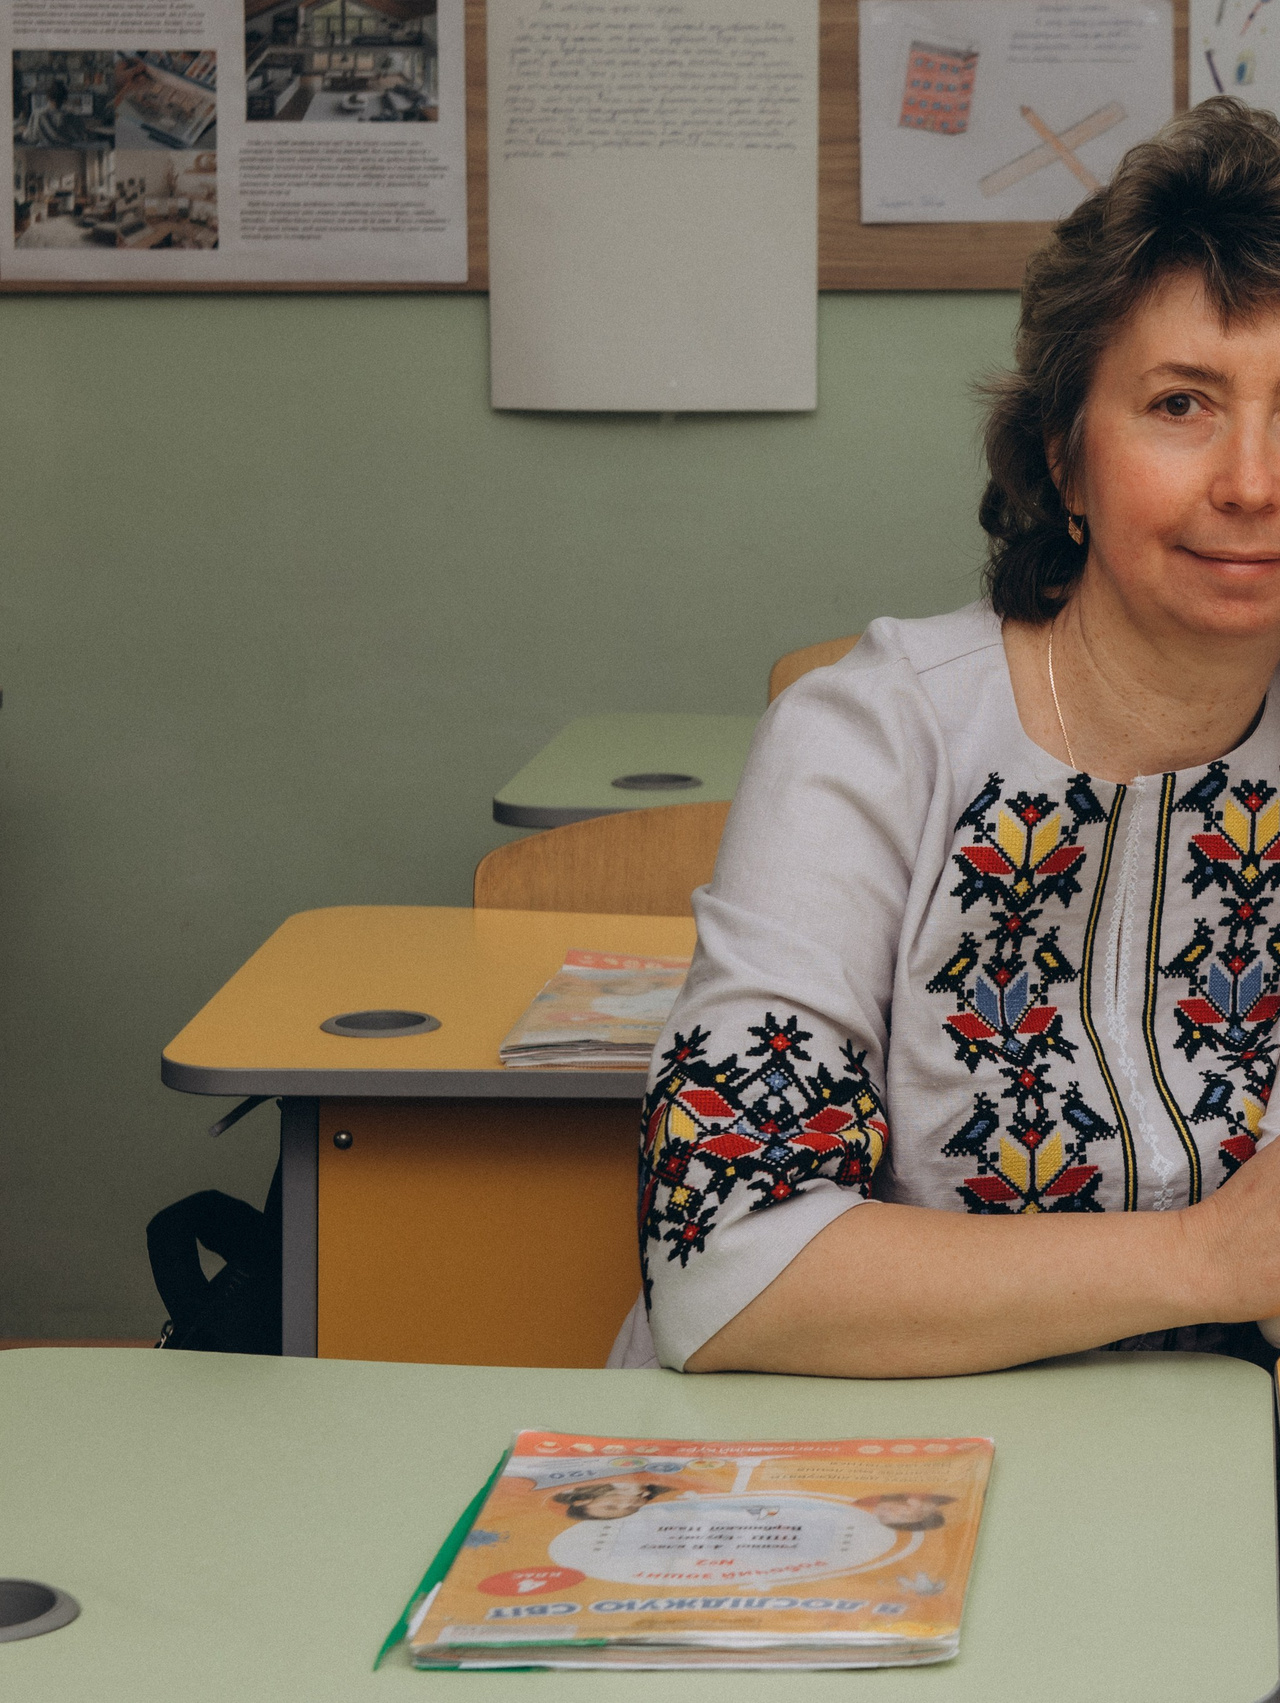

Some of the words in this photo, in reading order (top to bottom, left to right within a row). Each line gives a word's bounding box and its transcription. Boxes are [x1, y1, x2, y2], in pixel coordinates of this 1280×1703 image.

[517, 1579, 547, 1594] 4
[487, 1603, 580, 1619] СВІТ
[591, 1598, 868, 1613] ДОСЛІДЖУЮ
